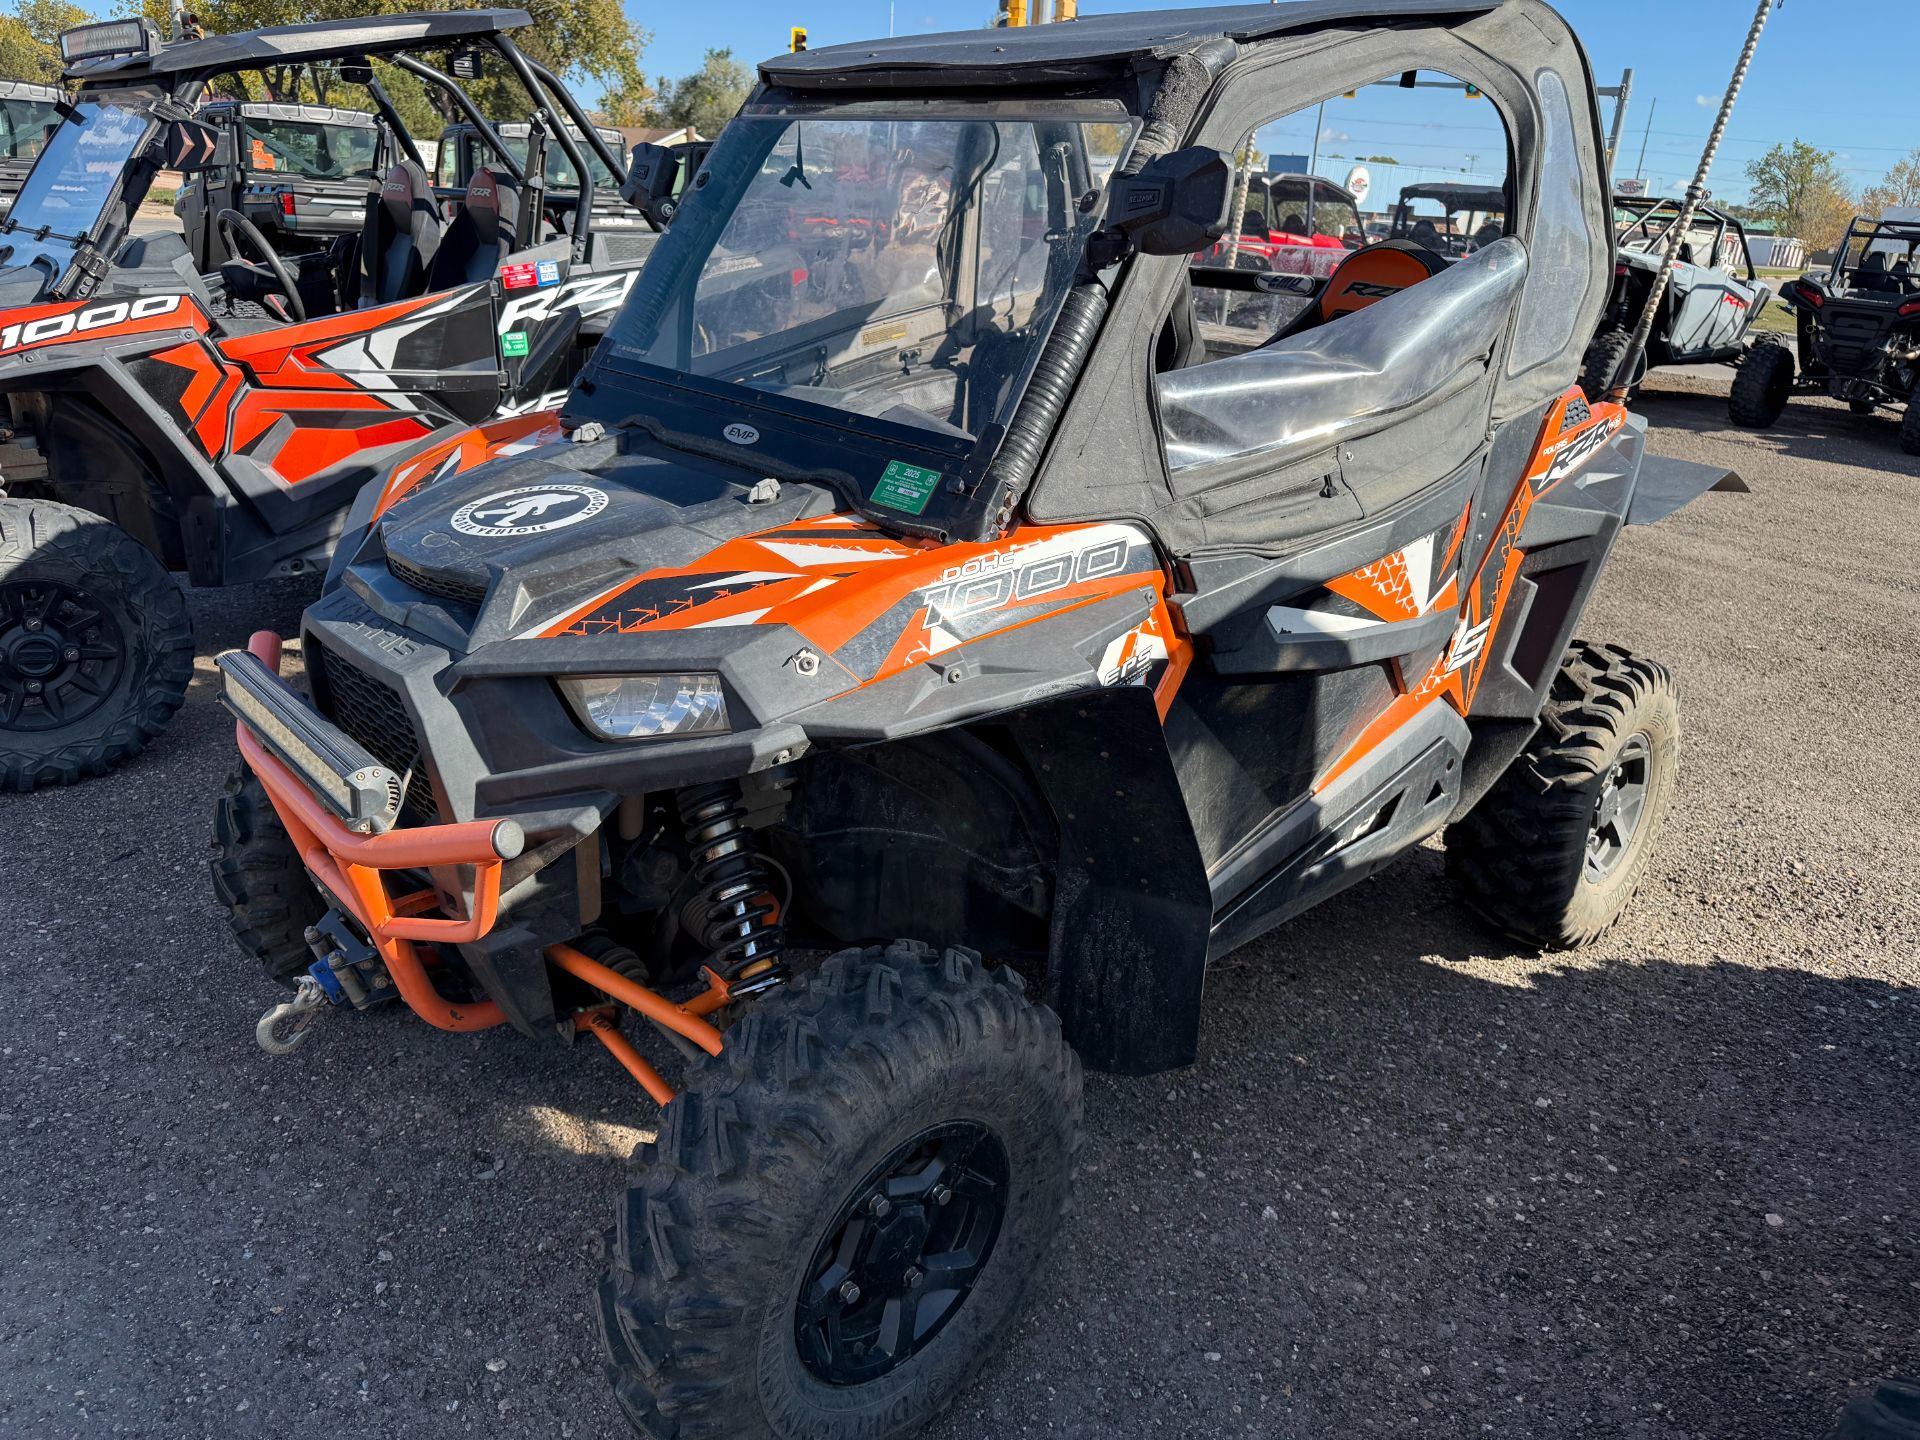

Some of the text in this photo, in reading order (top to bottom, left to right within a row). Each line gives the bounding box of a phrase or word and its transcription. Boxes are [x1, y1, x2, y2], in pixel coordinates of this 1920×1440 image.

[470, 187, 492, 197] RZR
[1, 295, 181, 350] 1000
[728, 427, 755, 440] EMP
[1543, 437, 1569, 456] POLARIS
[1537, 416, 1610, 490] RZR
[903, 468, 921, 479] 2025
[477, 524, 549, 535] VEHICLE
[942, 550, 1017, 584] DOHC
[922, 536, 1130, 630] 1000
[1103, 645, 1153, 686] EPS
